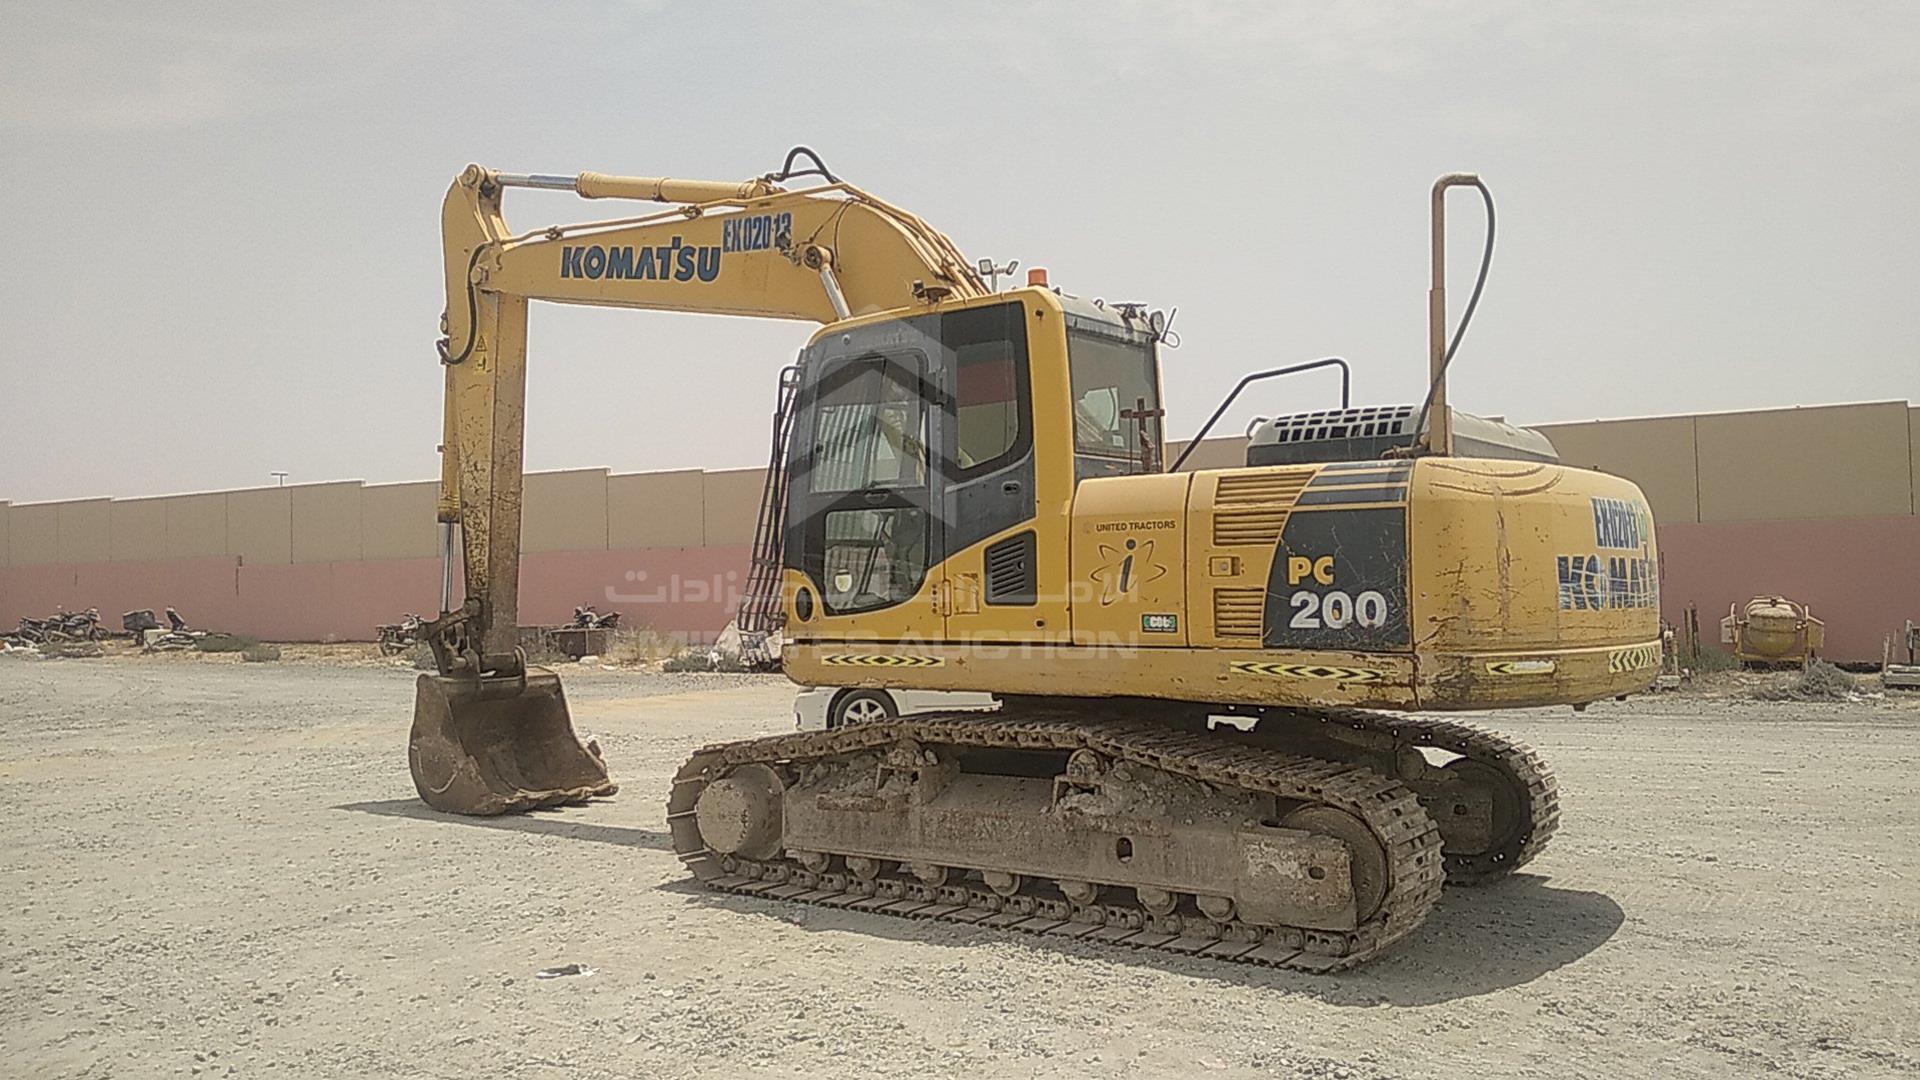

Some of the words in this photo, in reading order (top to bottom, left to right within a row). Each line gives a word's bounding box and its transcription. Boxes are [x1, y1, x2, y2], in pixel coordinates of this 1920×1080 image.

[560, 236, 722, 282] KOMATSU
[1096, 523, 1127, 532] UNITED
[1129, 520, 1176, 531] TRACTORS
[1288, 556, 1334, 585] PC
[1289, 590, 1387, 629] 200
